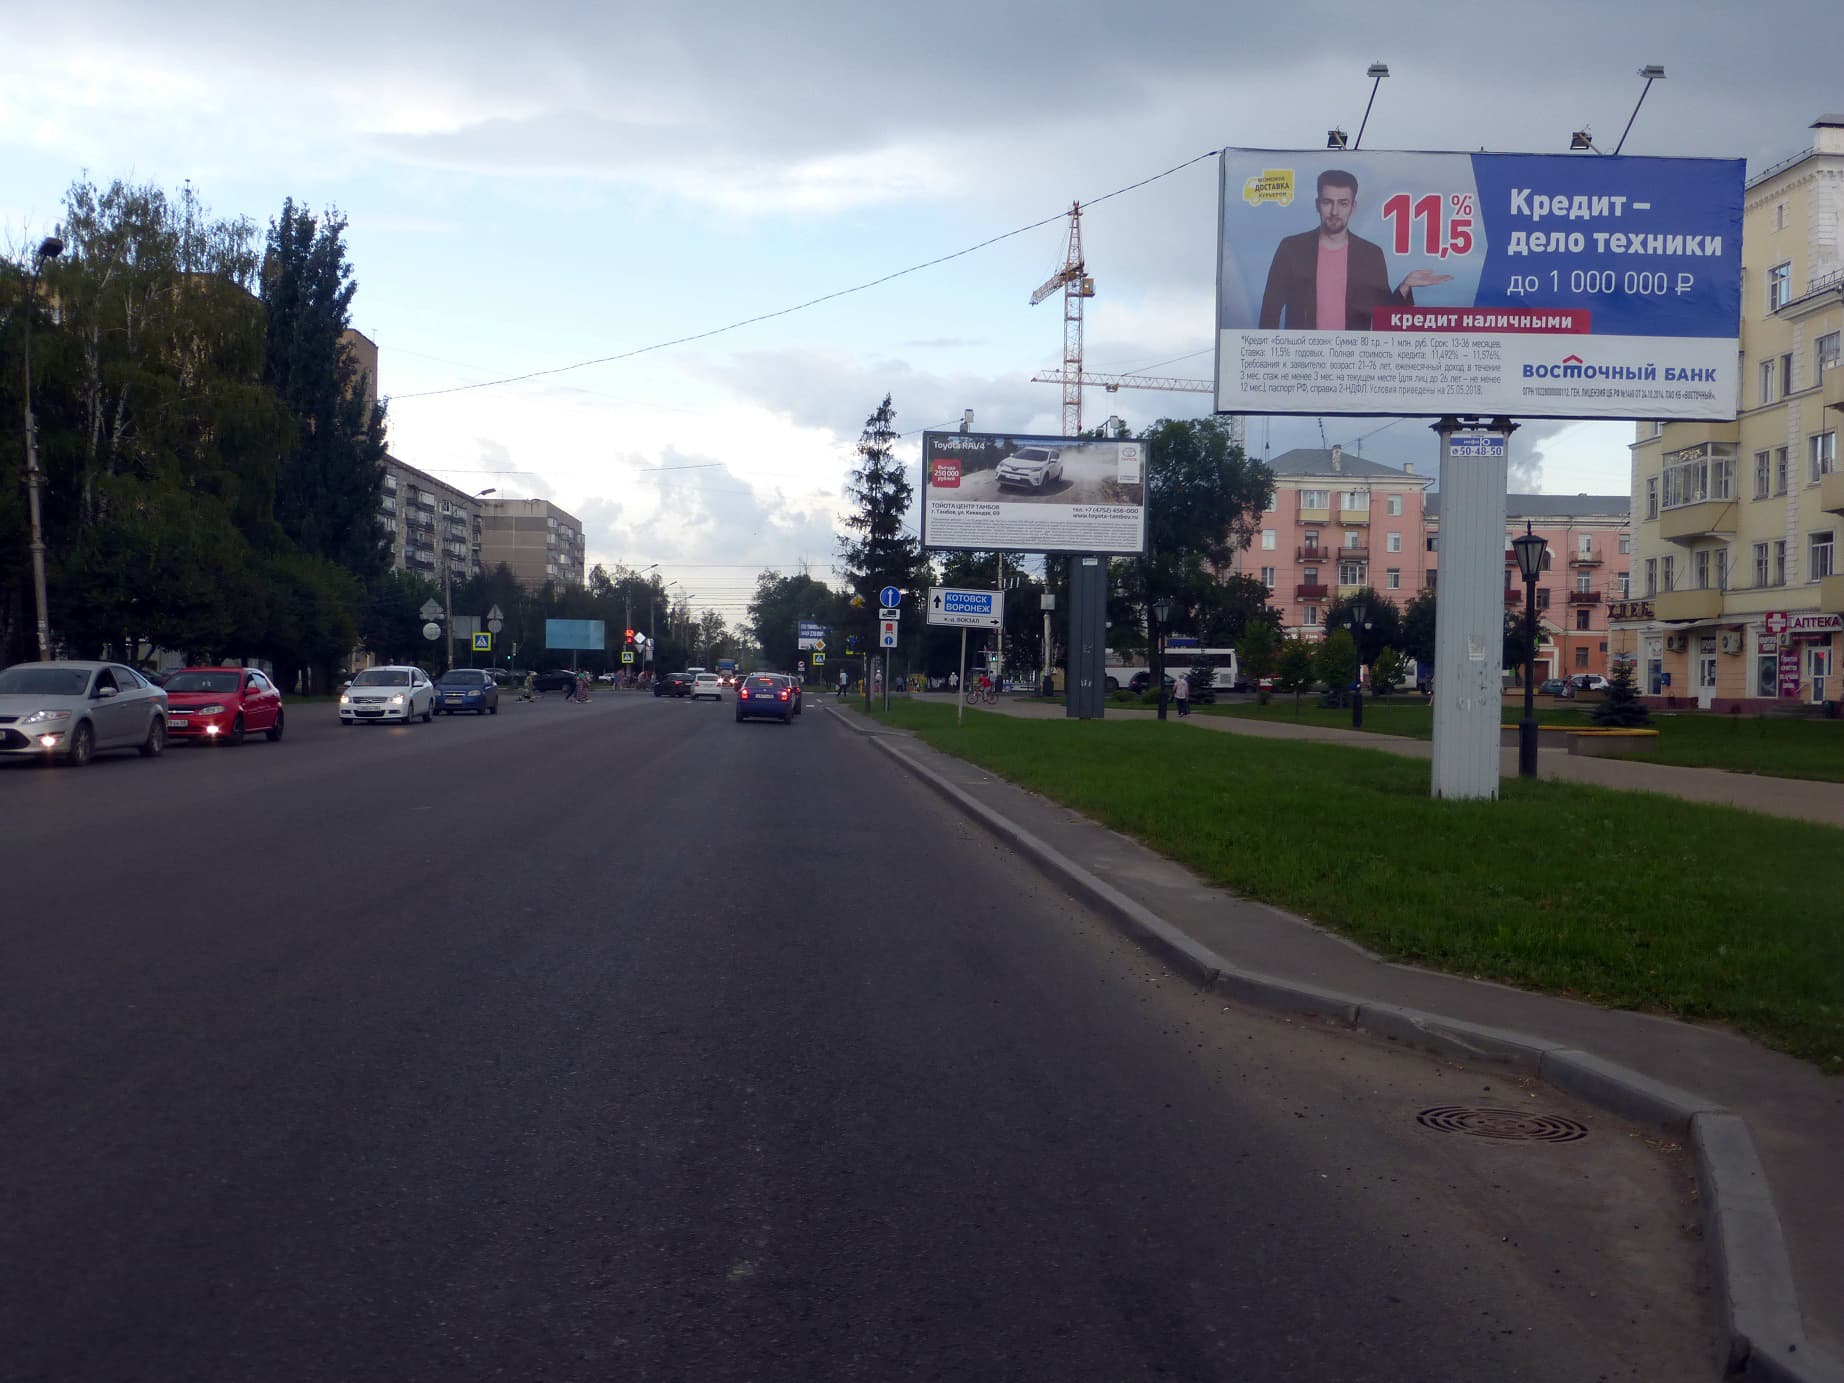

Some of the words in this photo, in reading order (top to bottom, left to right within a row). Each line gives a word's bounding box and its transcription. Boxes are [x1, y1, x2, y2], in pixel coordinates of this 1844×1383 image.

[1255, 183, 1290, 192] ДОСТАВКА
[1510, 188, 1627, 221] Кредит
[1508, 231, 1585, 255] дело
[1593, 232, 1722, 256] техники
[1507, 275, 1539, 296] до
[1391, 313, 1458, 330] кредит
[1462, 314, 1572, 329] наличными
[1330, 347, 1355, 358] Полная
[1359, 351, 1393, 359] стоимость
[1240, 359, 1280, 370] Требования
[1665, 367, 1717, 382] БАНК
[1268, 384, 1296, 395] паспорт
[1310, 385, 1338, 396] справка
[1399, 386, 1436, 396] приведены
[934, 441, 961, 450] Toyota
[962, 441, 986, 450] RAV4
[946, 594, 987, 602] КОТОВСК
[946, 603, 991, 612] ВОРОНЕЖ
[1794, 616, 1840, 627] АПТЕКА
